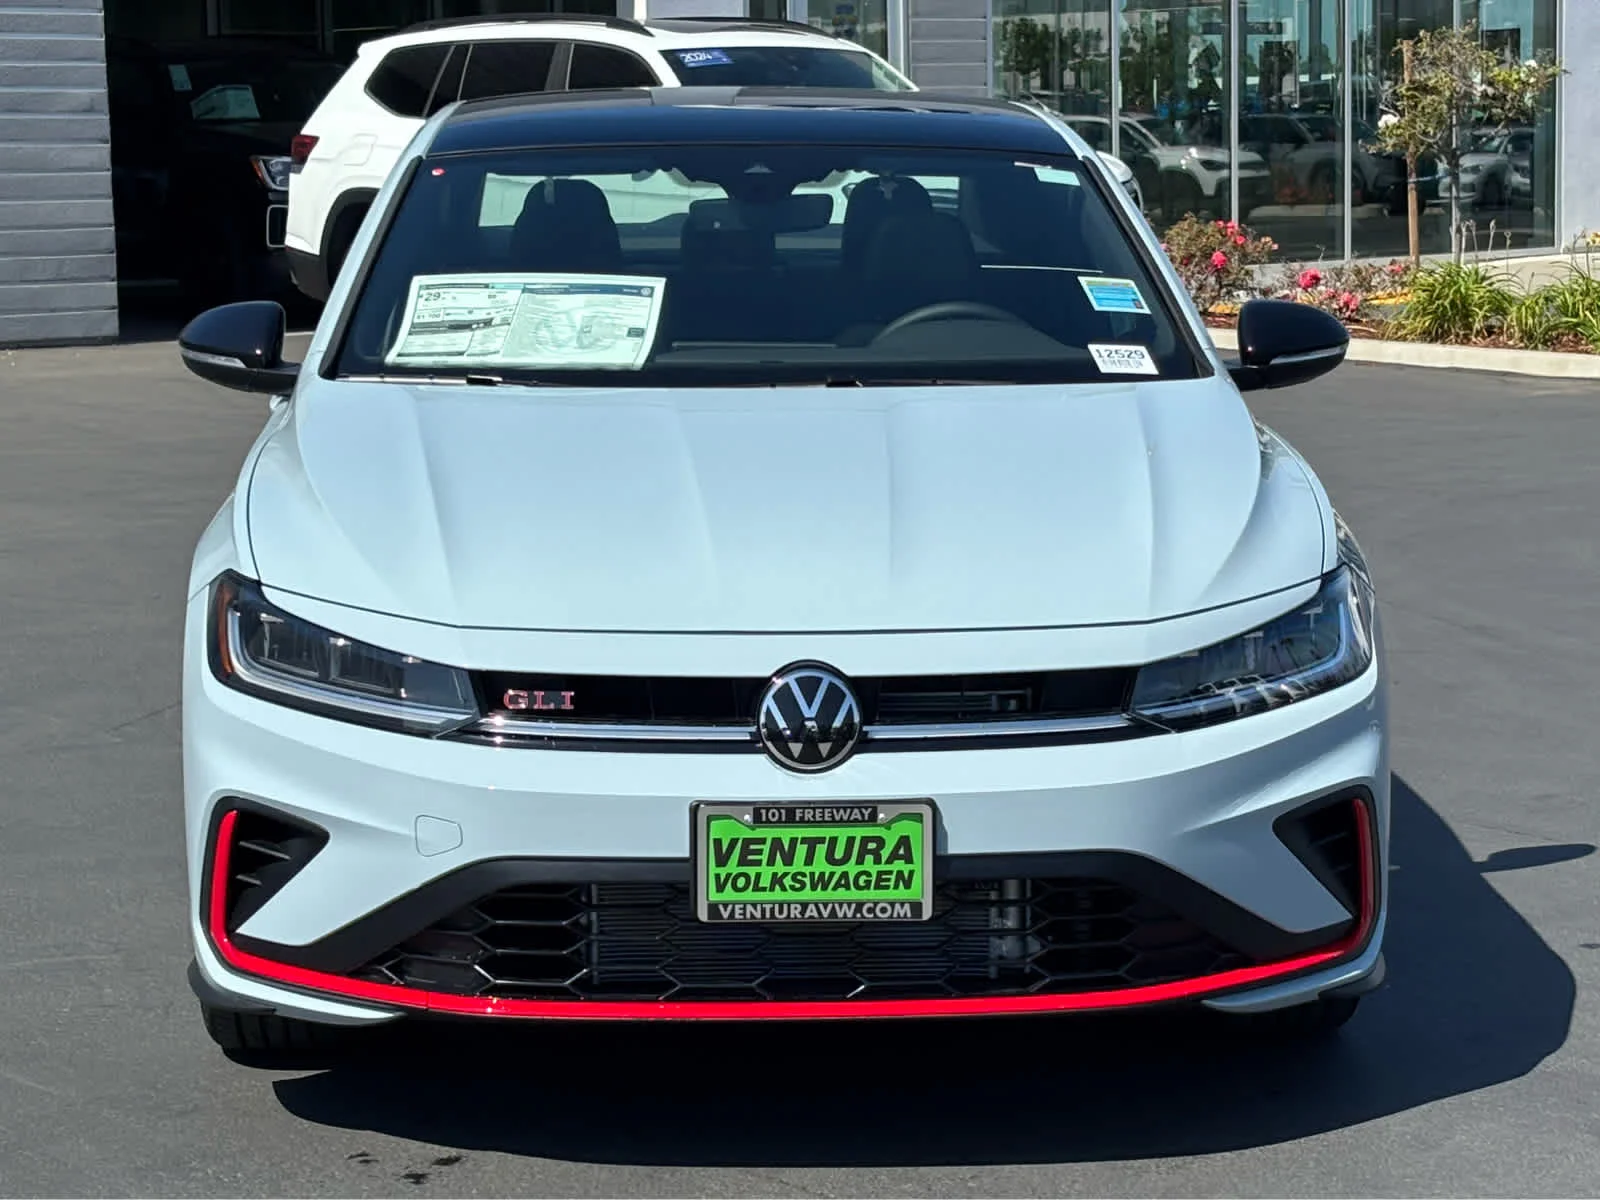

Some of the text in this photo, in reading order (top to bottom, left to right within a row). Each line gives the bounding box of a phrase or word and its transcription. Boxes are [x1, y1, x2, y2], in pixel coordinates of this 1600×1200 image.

[1095, 349, 1145, 359] 12529
[503, 689, 575, 711] GLI
[759, 808, 872, 822] 101 FREEWAY
[712, 835, 915, 867] VENTURA
[714, 869, 915, 894] VOLKSWAGEN
[718, 902, 912, 920] VENTURAVW.COM
